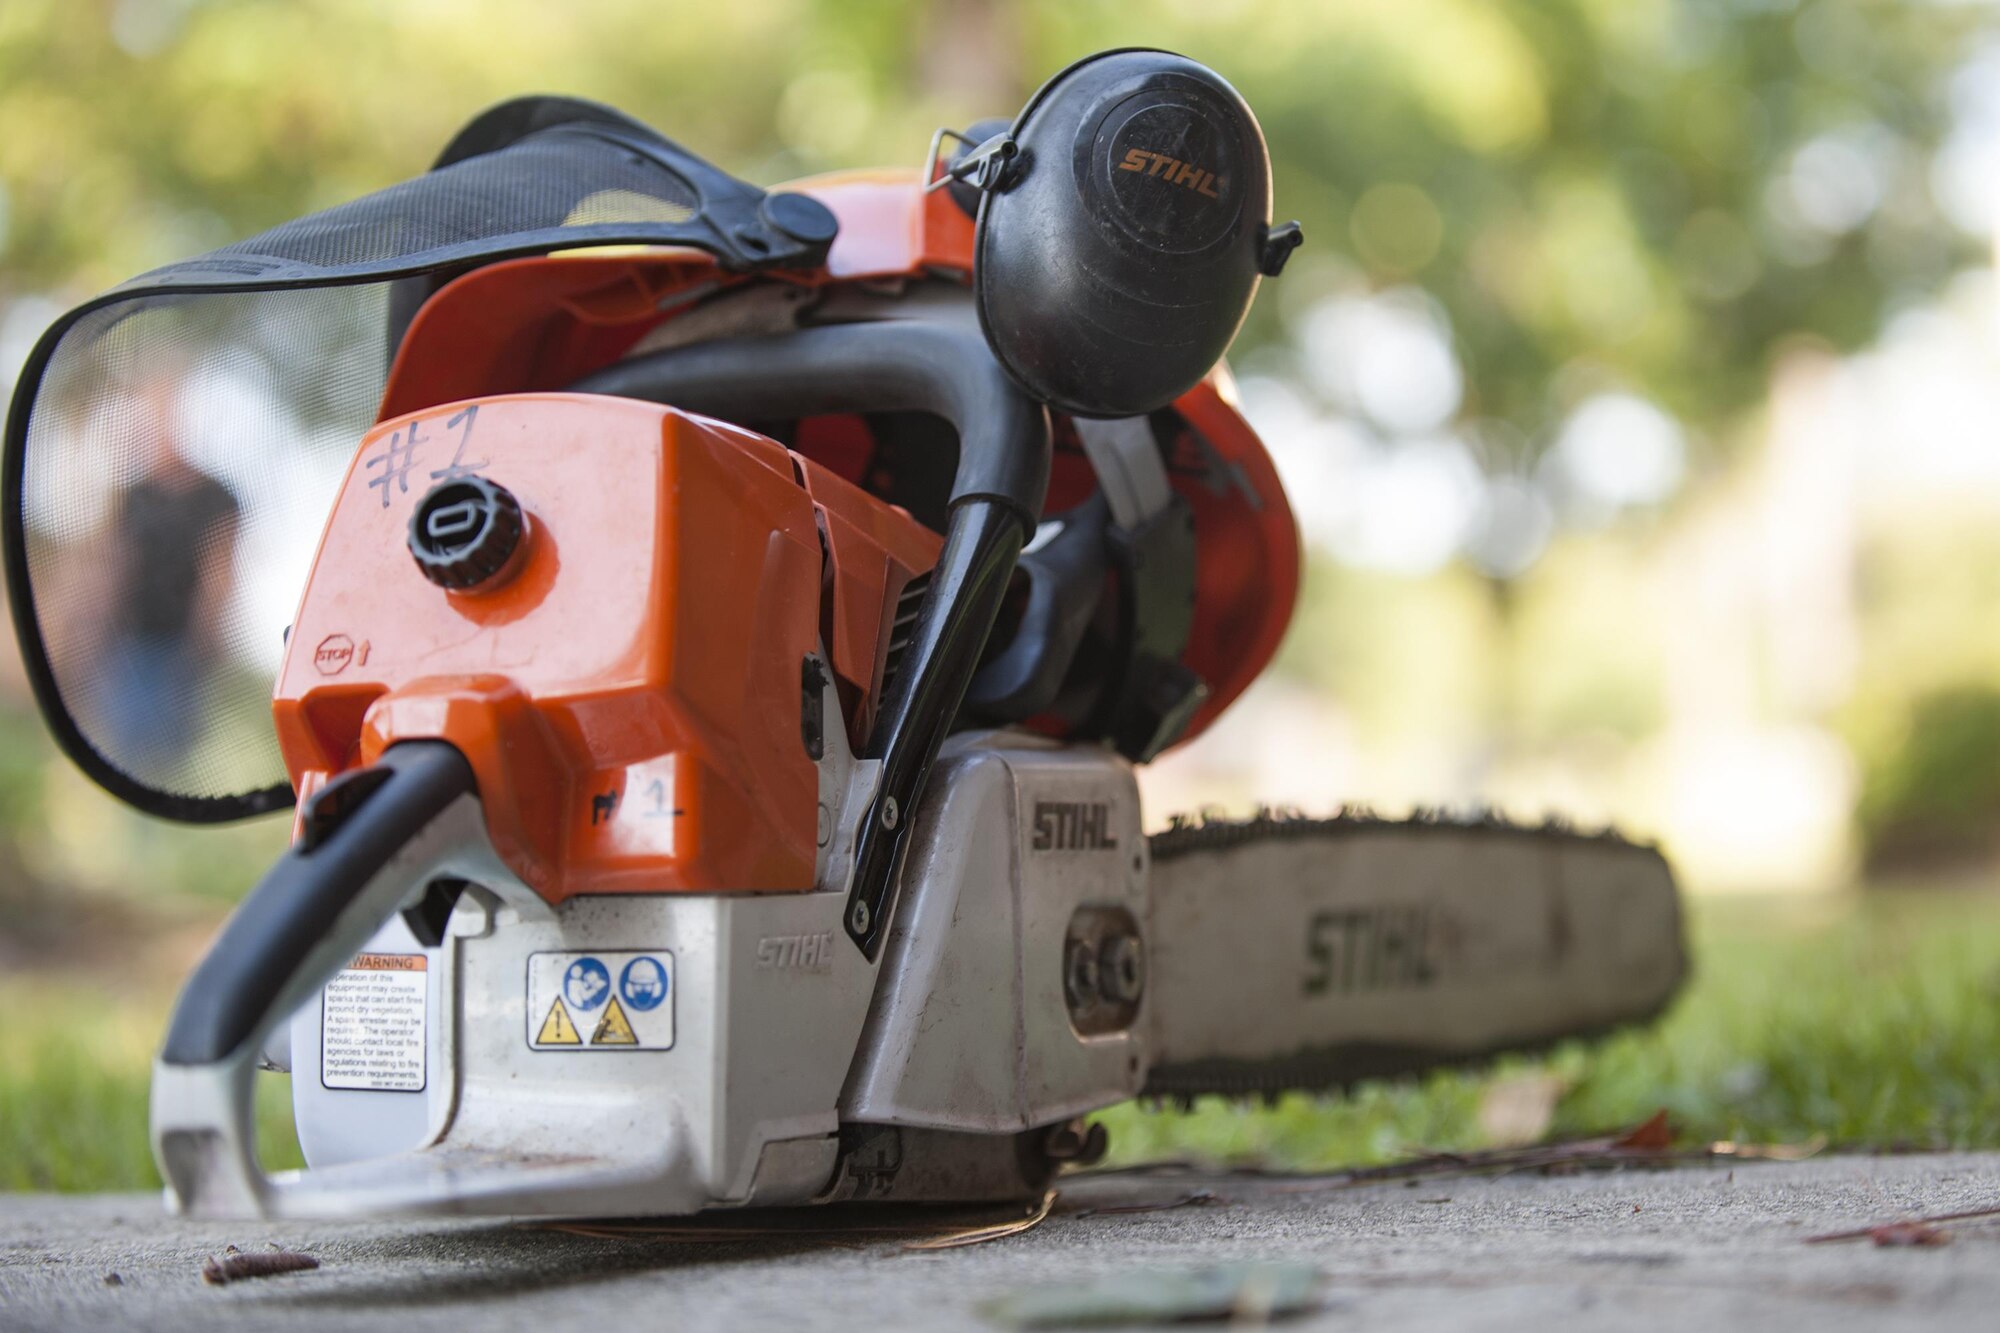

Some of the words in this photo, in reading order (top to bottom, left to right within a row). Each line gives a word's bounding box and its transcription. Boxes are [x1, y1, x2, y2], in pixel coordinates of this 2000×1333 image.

[1119, 148, 1219, 199] STIHL
[317, 648, 350, 661] STOP
[1033, 802, 1118, 850] STIHL
[755, 933, 832, 967] STIHL
[1301, 907, 1439, 996] STIHL
[353, 956, 414, 969] WARNING
[331, 974, 367, 983] peration
[369, 974, 378, 982] of
[380, 974, 393, 982] this
[371, 986, 388, 994] may
[328, 995, 353, 1004] sparks
[355, 995, 370, 1003] that
[387, 996, 404, 1004] start
[406, 996, 422, 1004] fires
[327, 1005, 355, 1013] around
[357, 1006, 369, 1014] dry
[391, 1018, 409, 1026] may
[364, 1027, 380, 1035] The
[381, 1028, 415, 1037] operator
[327, 1037, 352, 1045] should
[354, 1038, 383, 1046] contact
[327, 1048, 361, 1056] agencies
[364, 1048, 374, 1056] for
[326, 1058, 366, 1067] regulations
[368, 1060, 396, 1069] relating
[398, 1060, 406, 1068] to
[408, 1060, 420, 1068] fire
[326, 1069, 365, 1077] prevention
